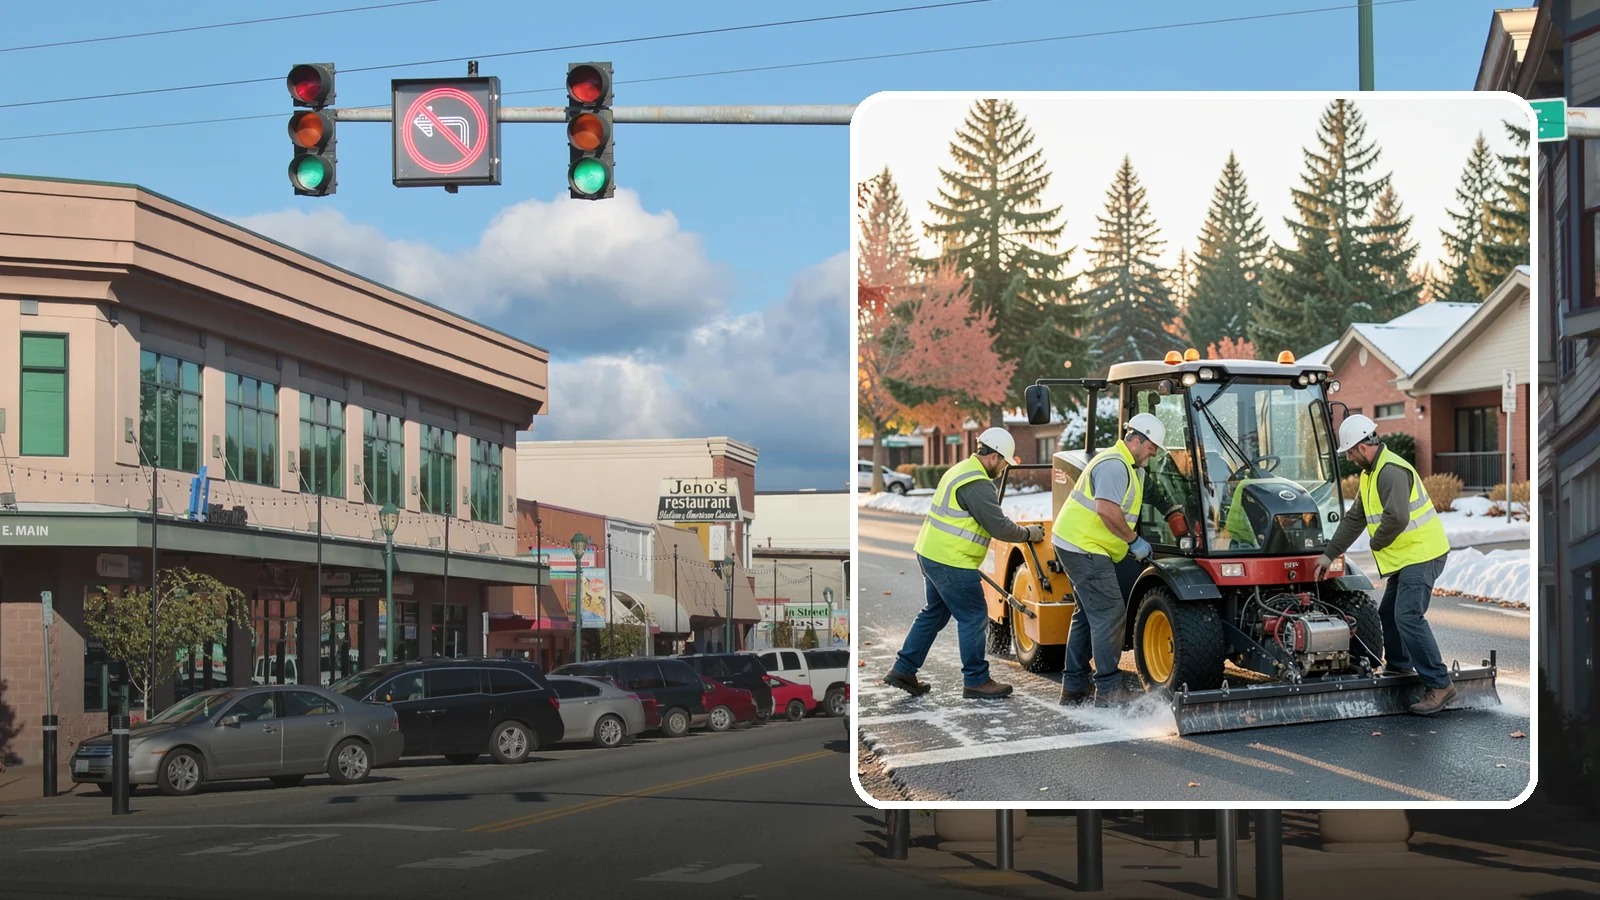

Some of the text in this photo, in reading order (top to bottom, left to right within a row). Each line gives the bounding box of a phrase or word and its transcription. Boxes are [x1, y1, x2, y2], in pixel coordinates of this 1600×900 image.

[669, 480, 728, 495] Jeno's
[665, 496, 731, 509] restaurant
[658, 510, 681, 519] Italian
[686, 510, 714, 519] American
[714, 509, 738, 519] Cuisine
[2, 525, 49, 536] E. MAIN
[797, 607, 829, 617] Street
